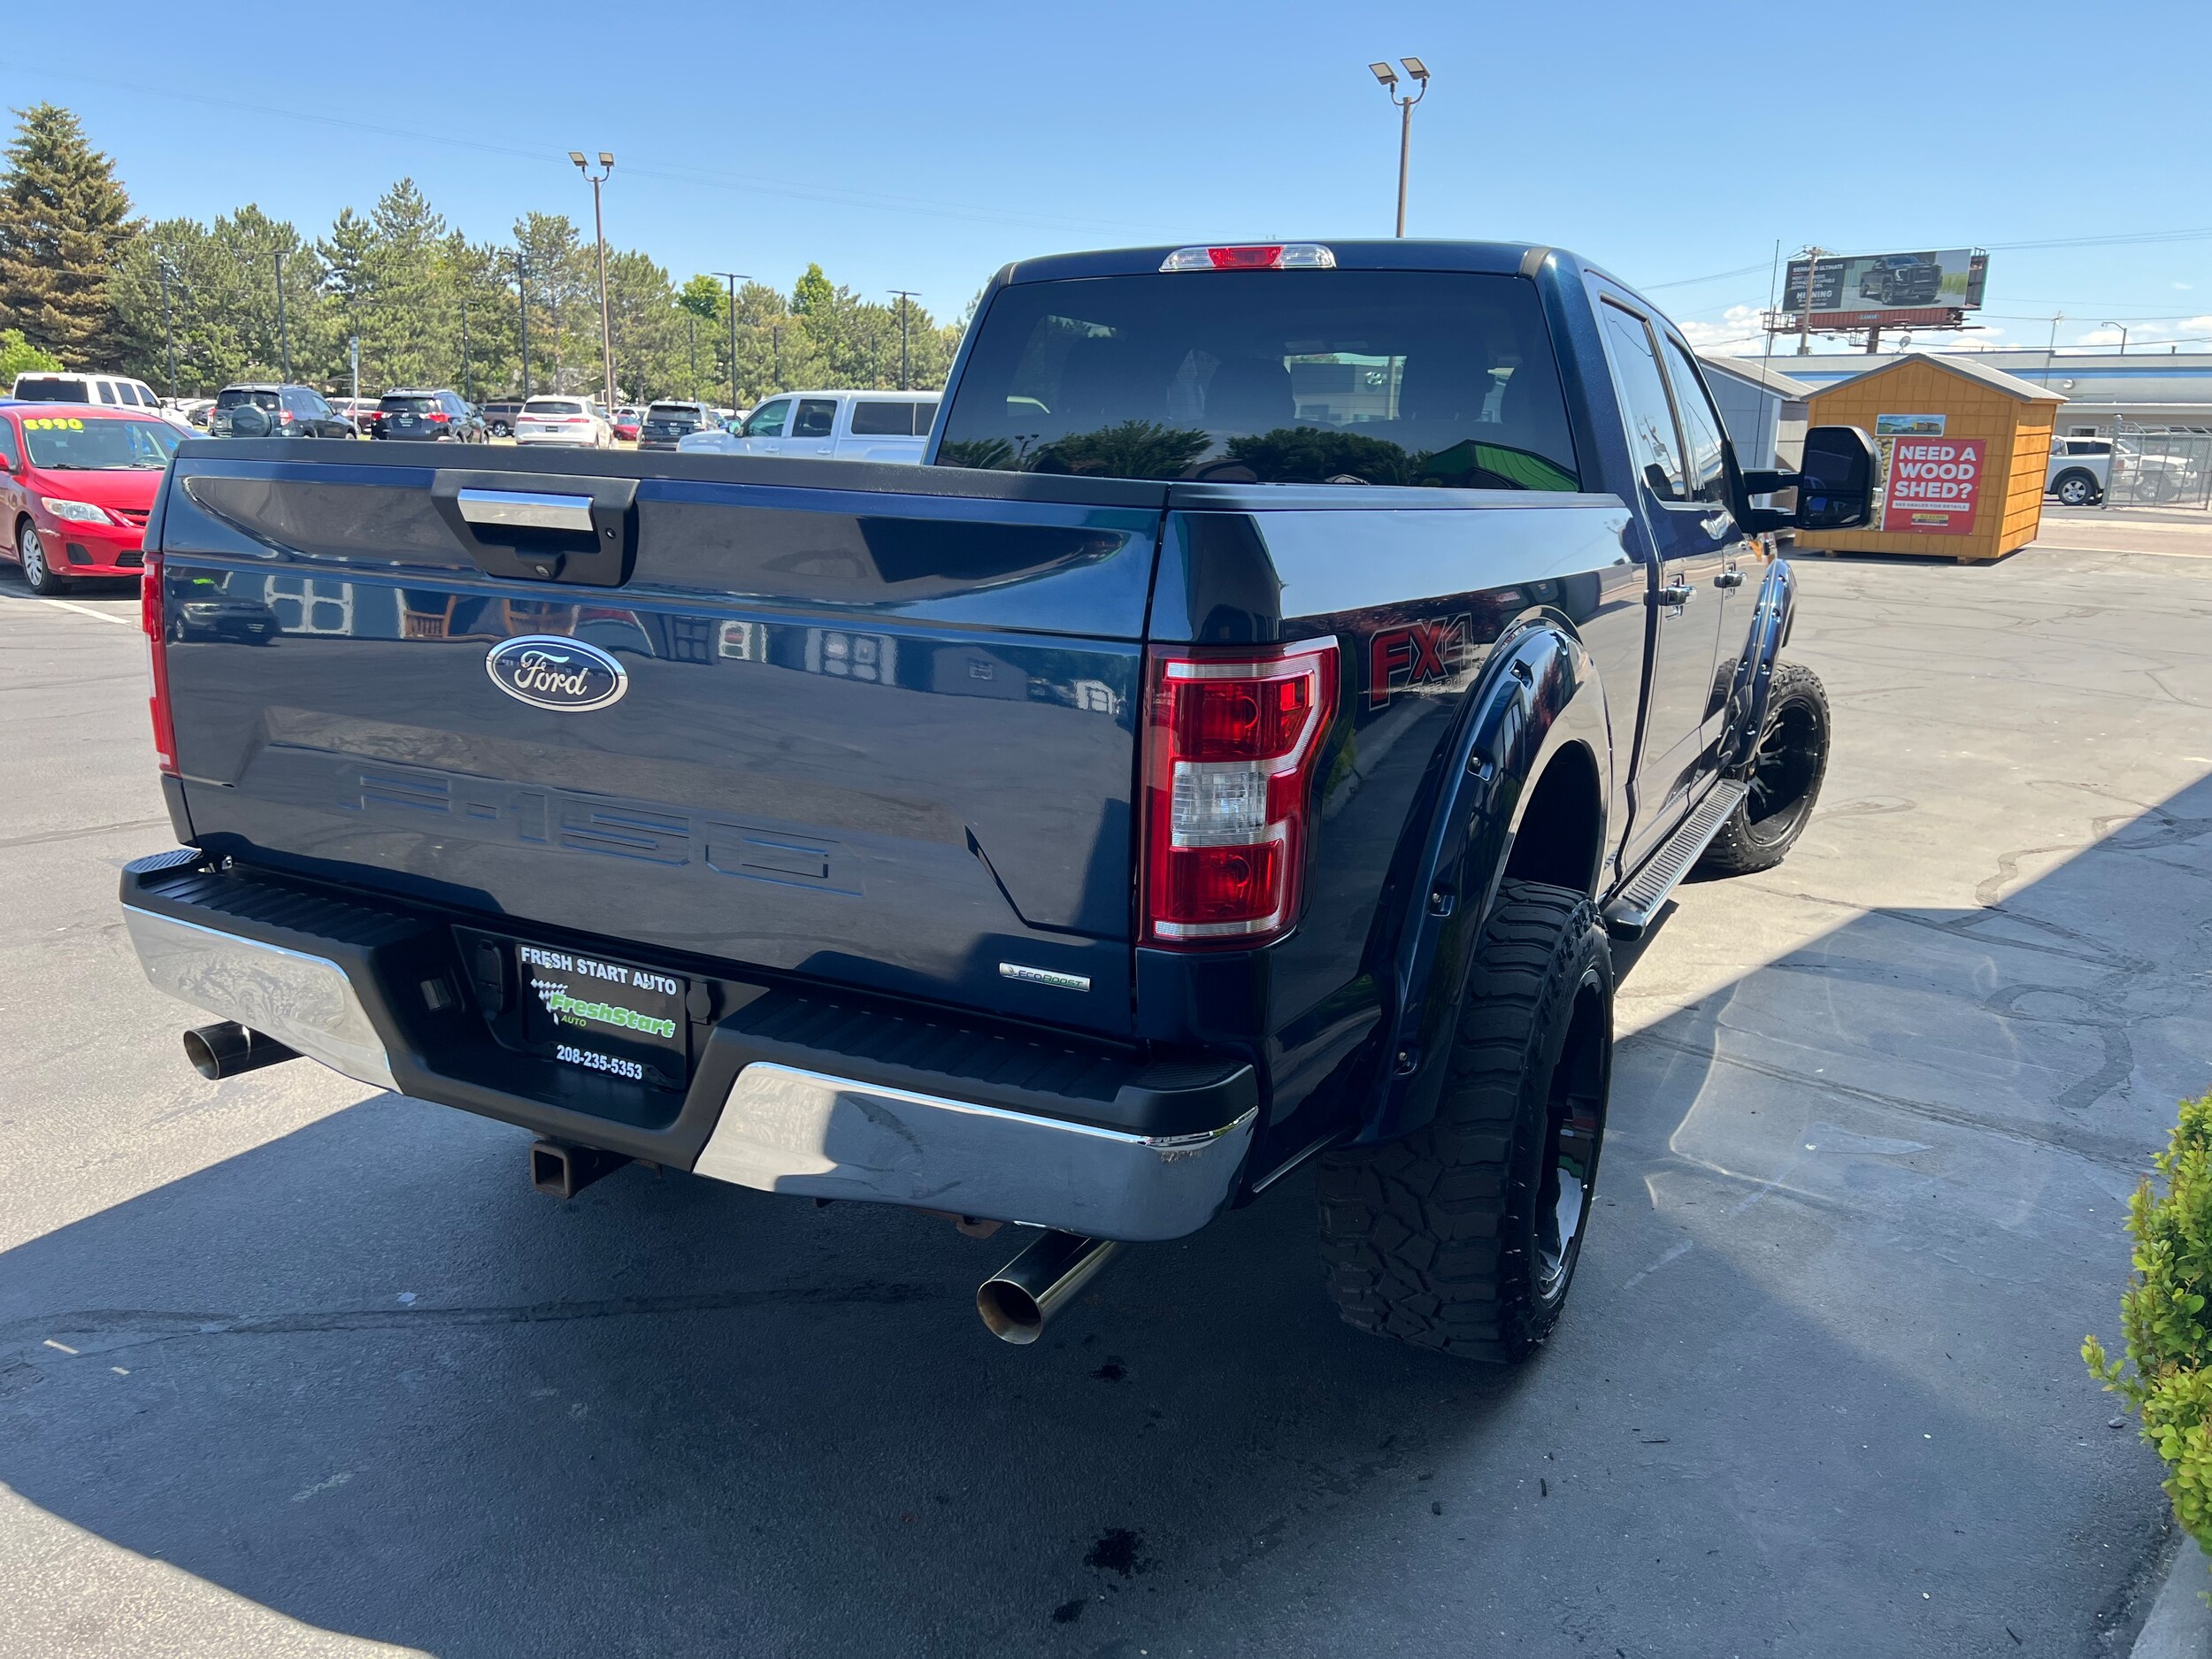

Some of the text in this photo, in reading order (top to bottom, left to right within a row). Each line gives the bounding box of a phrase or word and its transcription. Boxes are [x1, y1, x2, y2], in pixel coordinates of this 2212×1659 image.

[23, 418, 83, 430] 8990
[1899, 446, 1977, 461] NEED A
[1898, 462, 1975, 480] WOOD
[1893, 480, 1972, 499] SHED?
[1369, 611, 1474, 711] FX4
[514, 649, 589, 696] Ford
[520, 946, 678, 995] FRESH START AUTO
[1018, 971, 1083, 987] ECOBOOST
[549, 993, 677, 1039] FreshStart
[560, 1014, 588, 1027] AUTO
[556, 1044, 643, 1080] 208-235-5353
